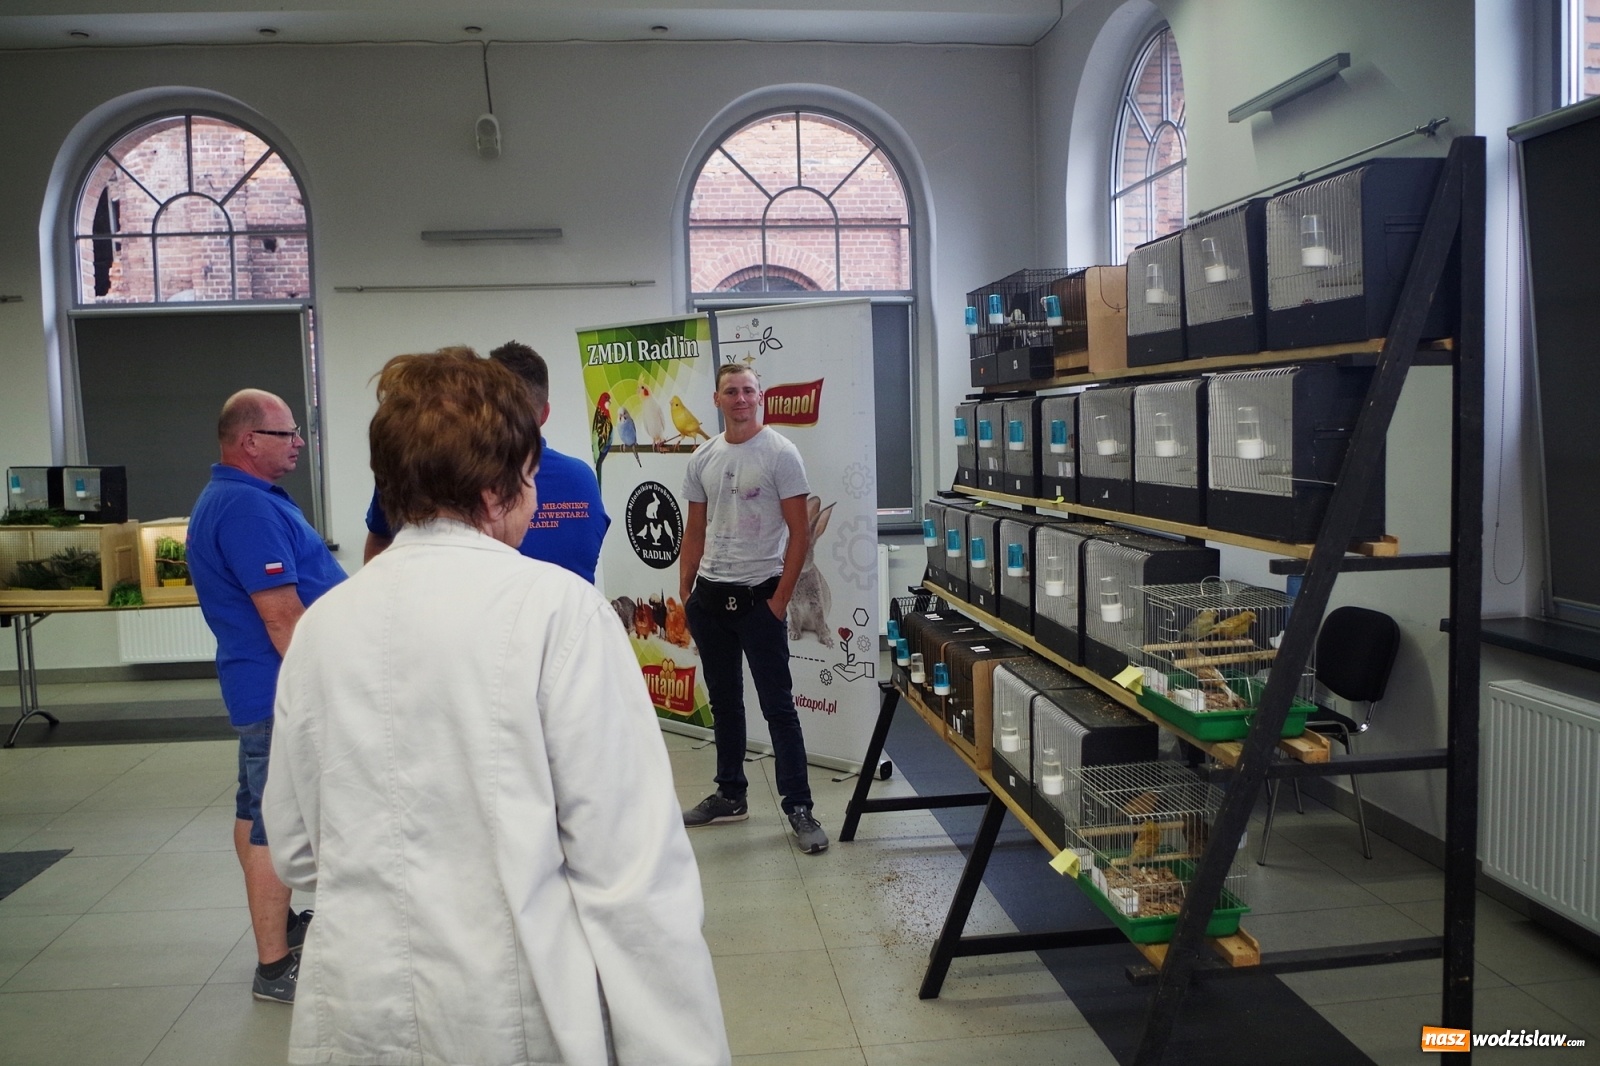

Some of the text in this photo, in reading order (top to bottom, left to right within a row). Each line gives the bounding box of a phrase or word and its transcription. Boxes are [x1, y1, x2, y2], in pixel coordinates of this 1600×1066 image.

[588, 336, 700, 366] ZMDI Radlin
[767, 388, 817, 417] Vitapol
[542, 502, 589, 510] MIŁOŚNIKÓW
[538, 511, 589, 519] INWENTARZA
[529, 521, 559, 529] RADLIN
[642, 549, 672, 561] RADLIN
[793, 693, 838, 716] .vitapol.pl
